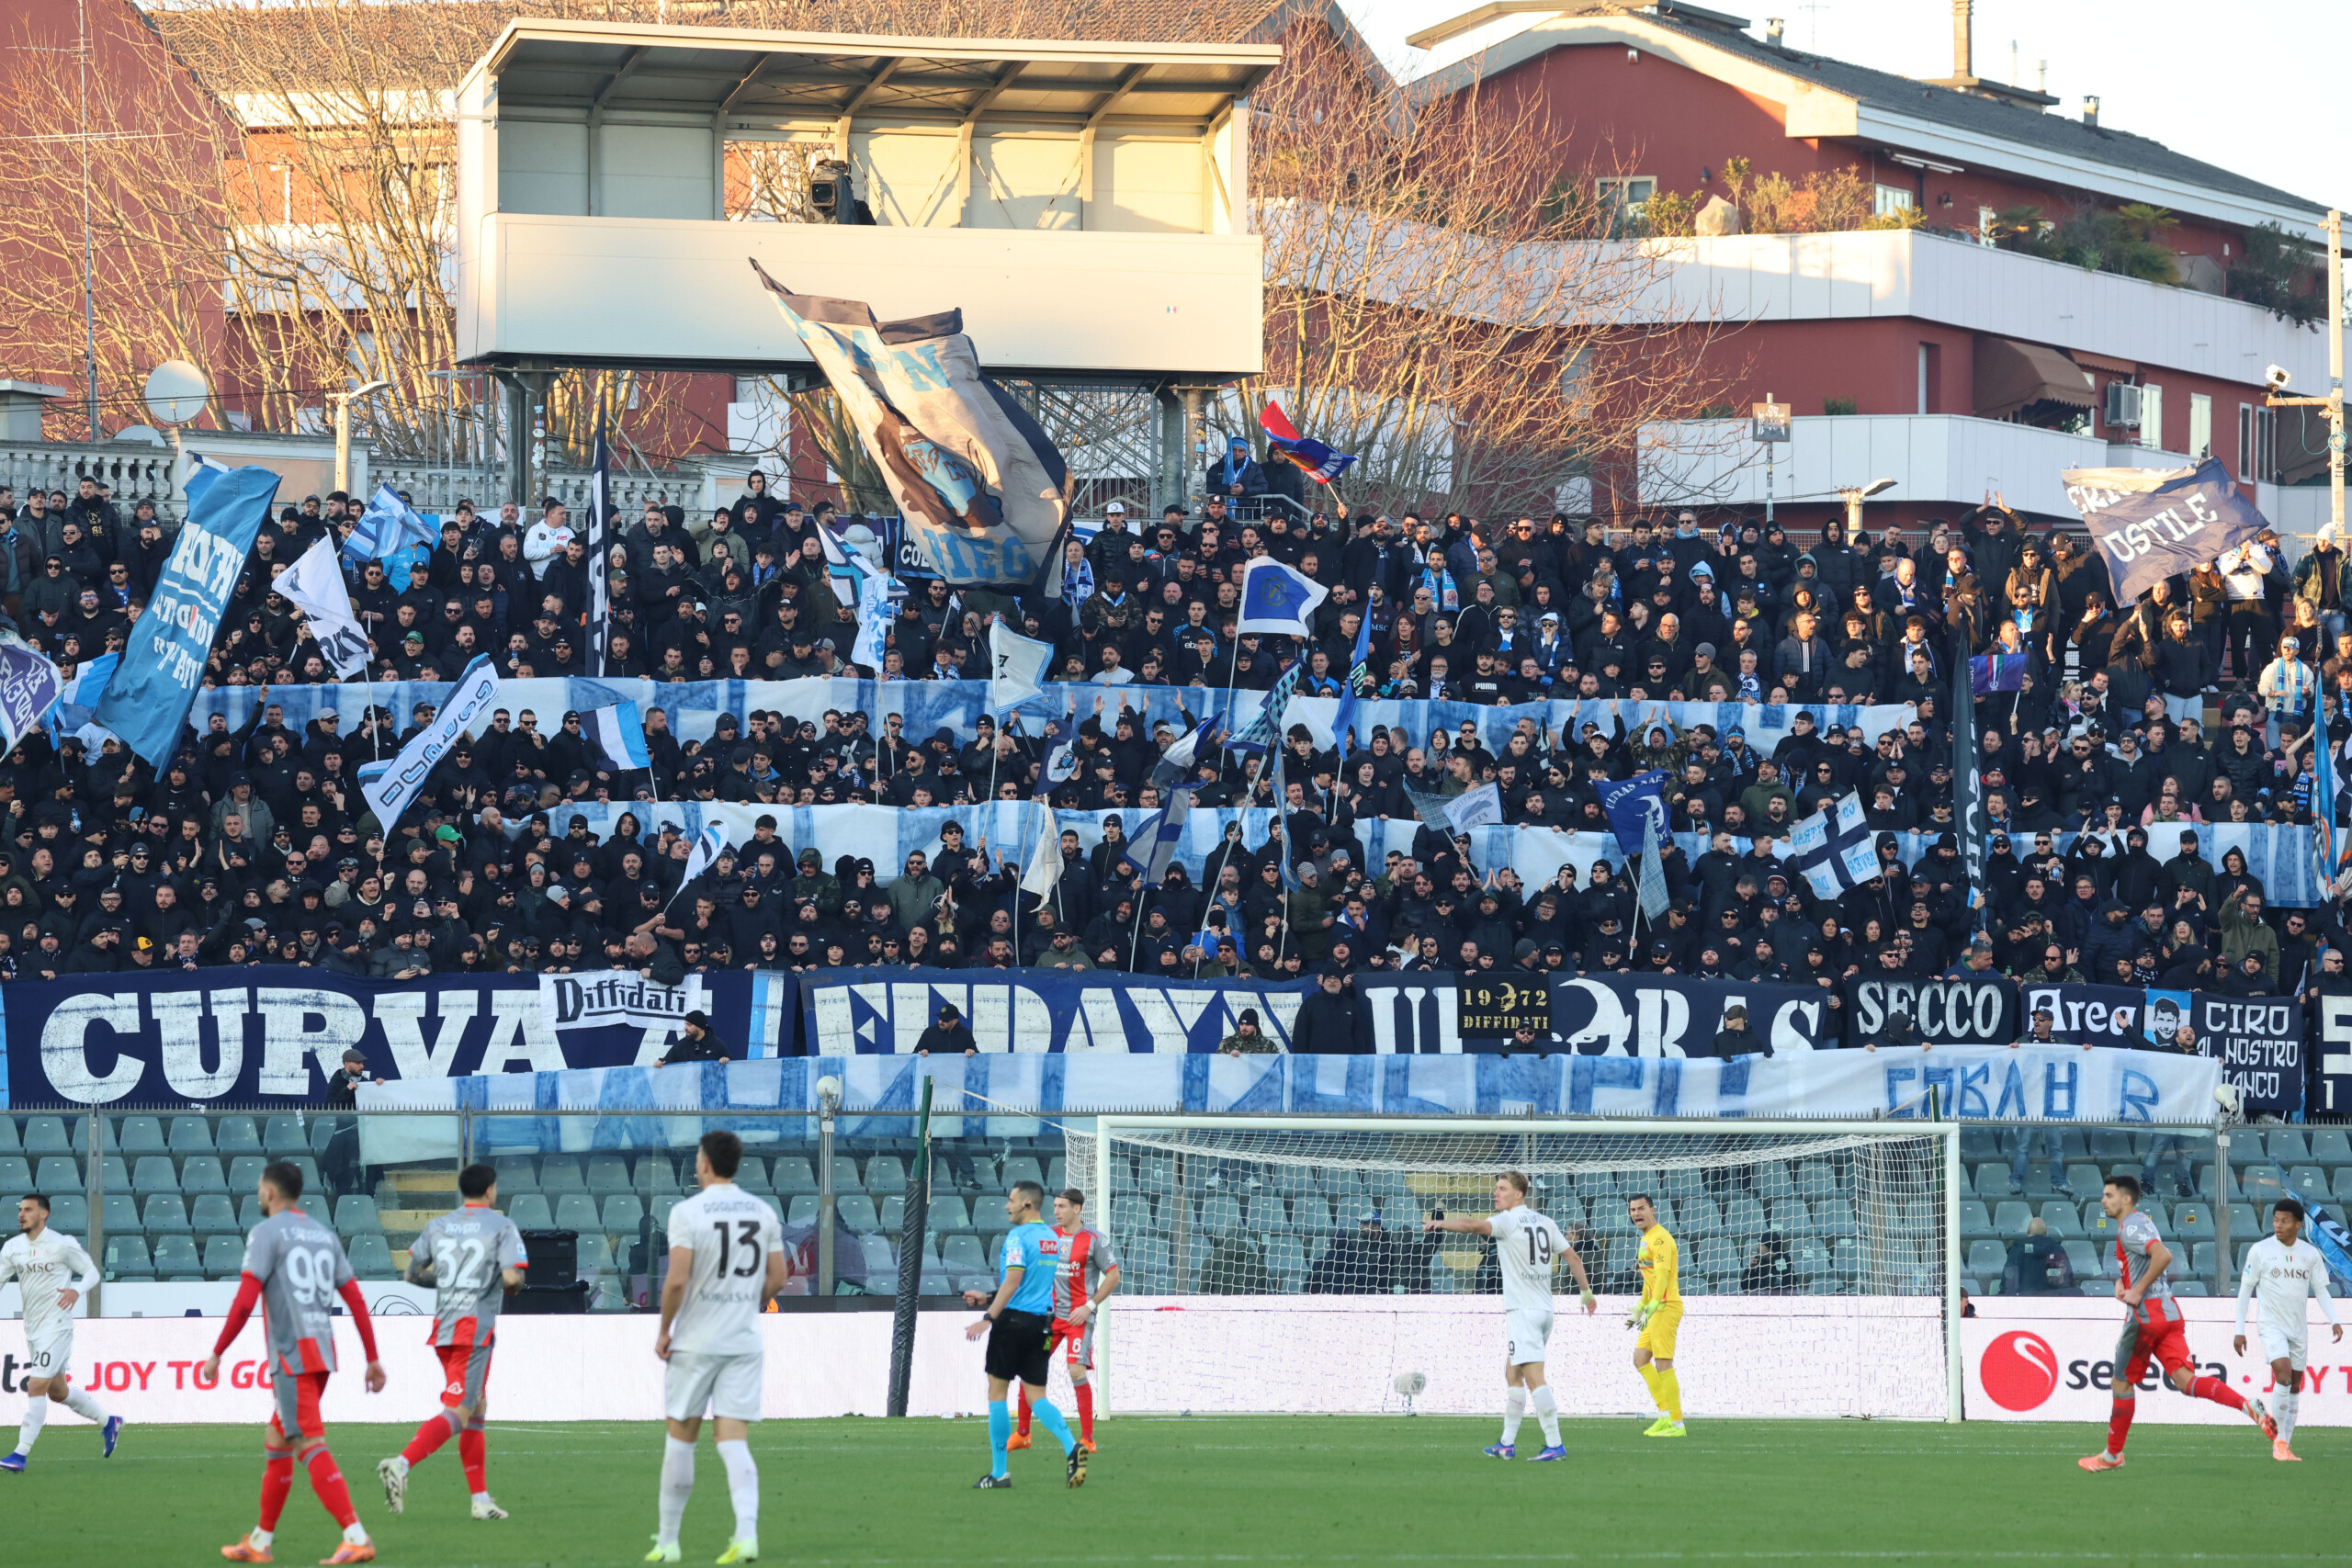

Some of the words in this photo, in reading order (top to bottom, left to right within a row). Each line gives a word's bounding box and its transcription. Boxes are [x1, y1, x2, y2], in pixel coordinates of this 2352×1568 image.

[2102, 491, 2219, 563] OSTILE
[923, 527, 1035, 580] DIEG
[1605, 783, 1635, 809] ULTRAS
[553, 977, 687, 1023] Diffidati
[1464, 988, 1491, 1006] 19
[1520, 989, 1548, 1007] 72
[1856, 981, 2003, 1039] SECCO
[2027, 987, 2137, 1036] Area
[2205, 1001, 2290, 1036] CIRO
[40, 987, 568, 1102] CURVA
[2225, 1036, 2299, 1068] NOSTRO
[2222, 1071, 2280, 1100] IANCO
[436, 1237, 485, 1289] 32
[713, 1220, 761, 1279] 13
[1523, 1226, 1551, 1266] 19
[26, 1262, 54, 1273] MSC
[286, 1246, 334, 1307] 99
[2283, 1267, 2310, 1280] MSC
[32, 1351, 51, 1368] 20
[1071, 1337, 1082, 1353] 6
[85, 1360, 157, 1392] JOY
[167, 1360, 220, 1391] TO
